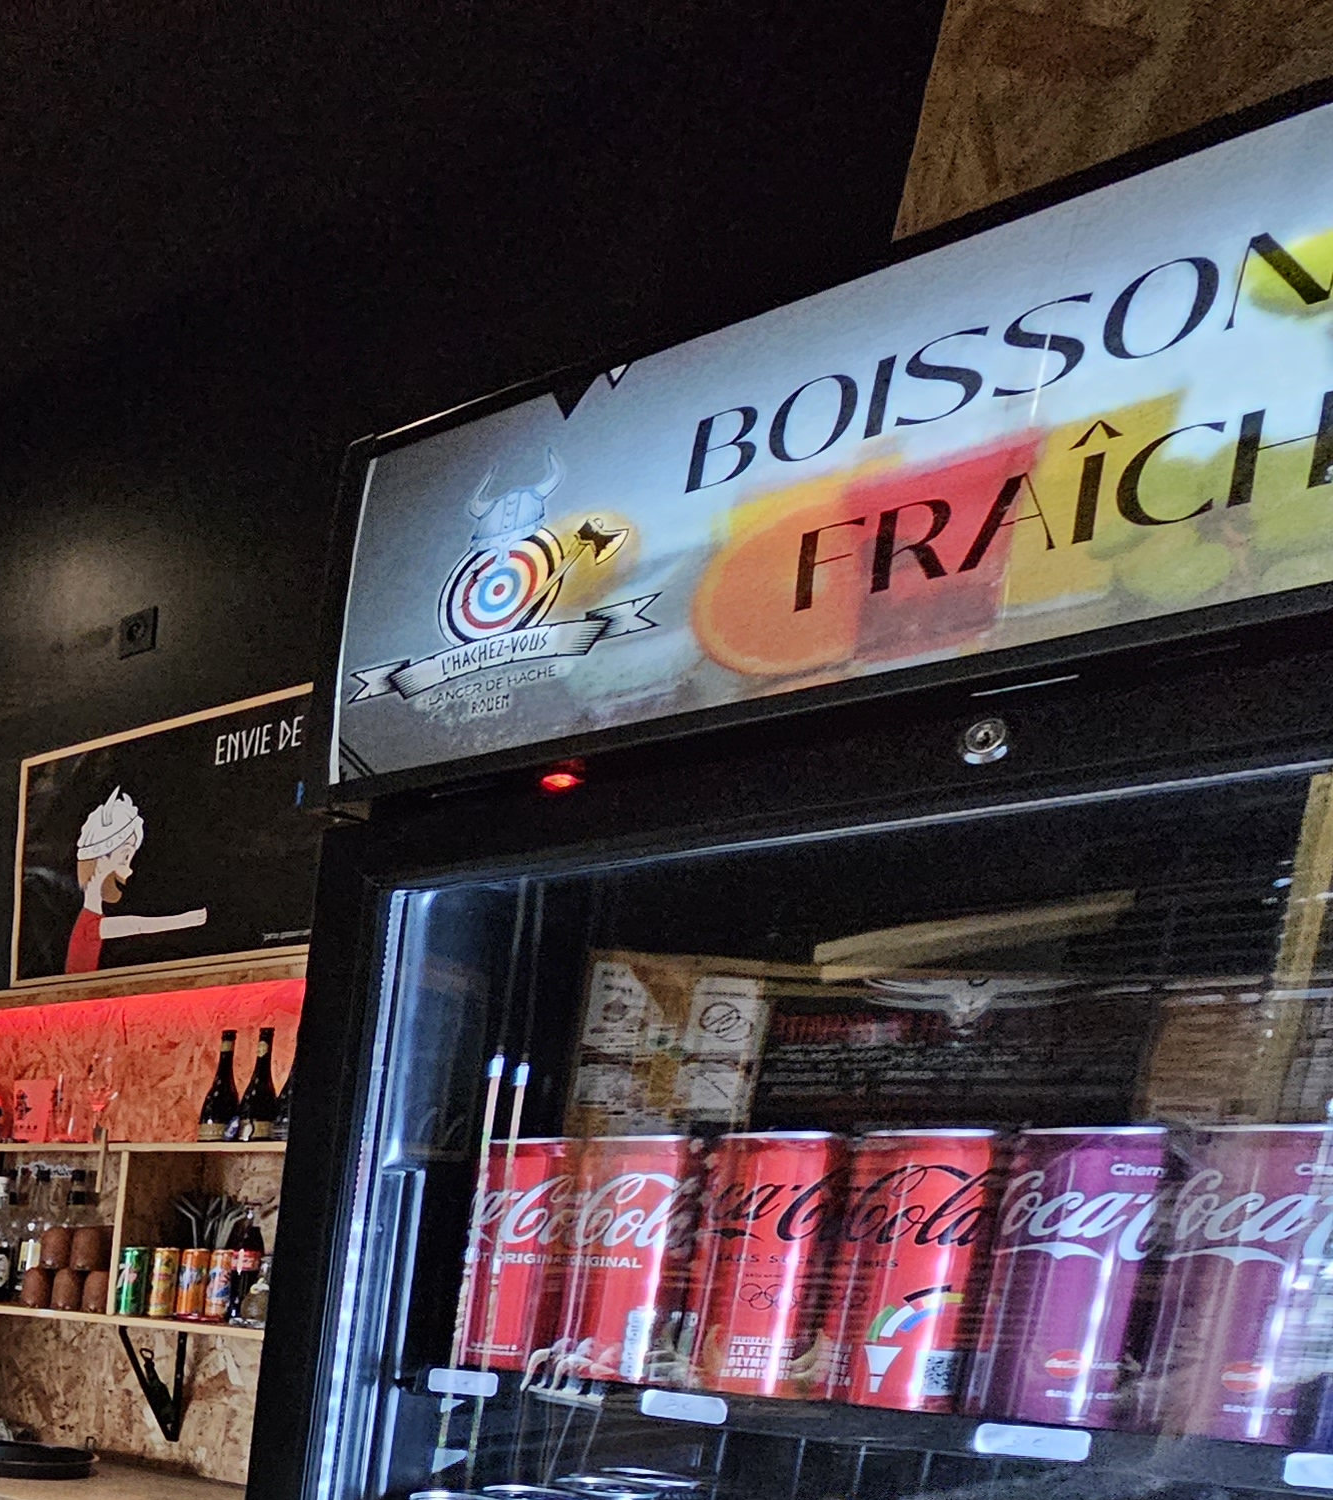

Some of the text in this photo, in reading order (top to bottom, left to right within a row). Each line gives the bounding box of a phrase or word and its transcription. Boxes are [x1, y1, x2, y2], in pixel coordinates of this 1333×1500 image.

[441, 630, 547, 676] L'HACHEZ-VOUS
[429, 664, 556, 706] LANCER DE HACHE
[471, 694, 511, 714] ROUEN
[214, 715, 304, 766] ENVIE DE
